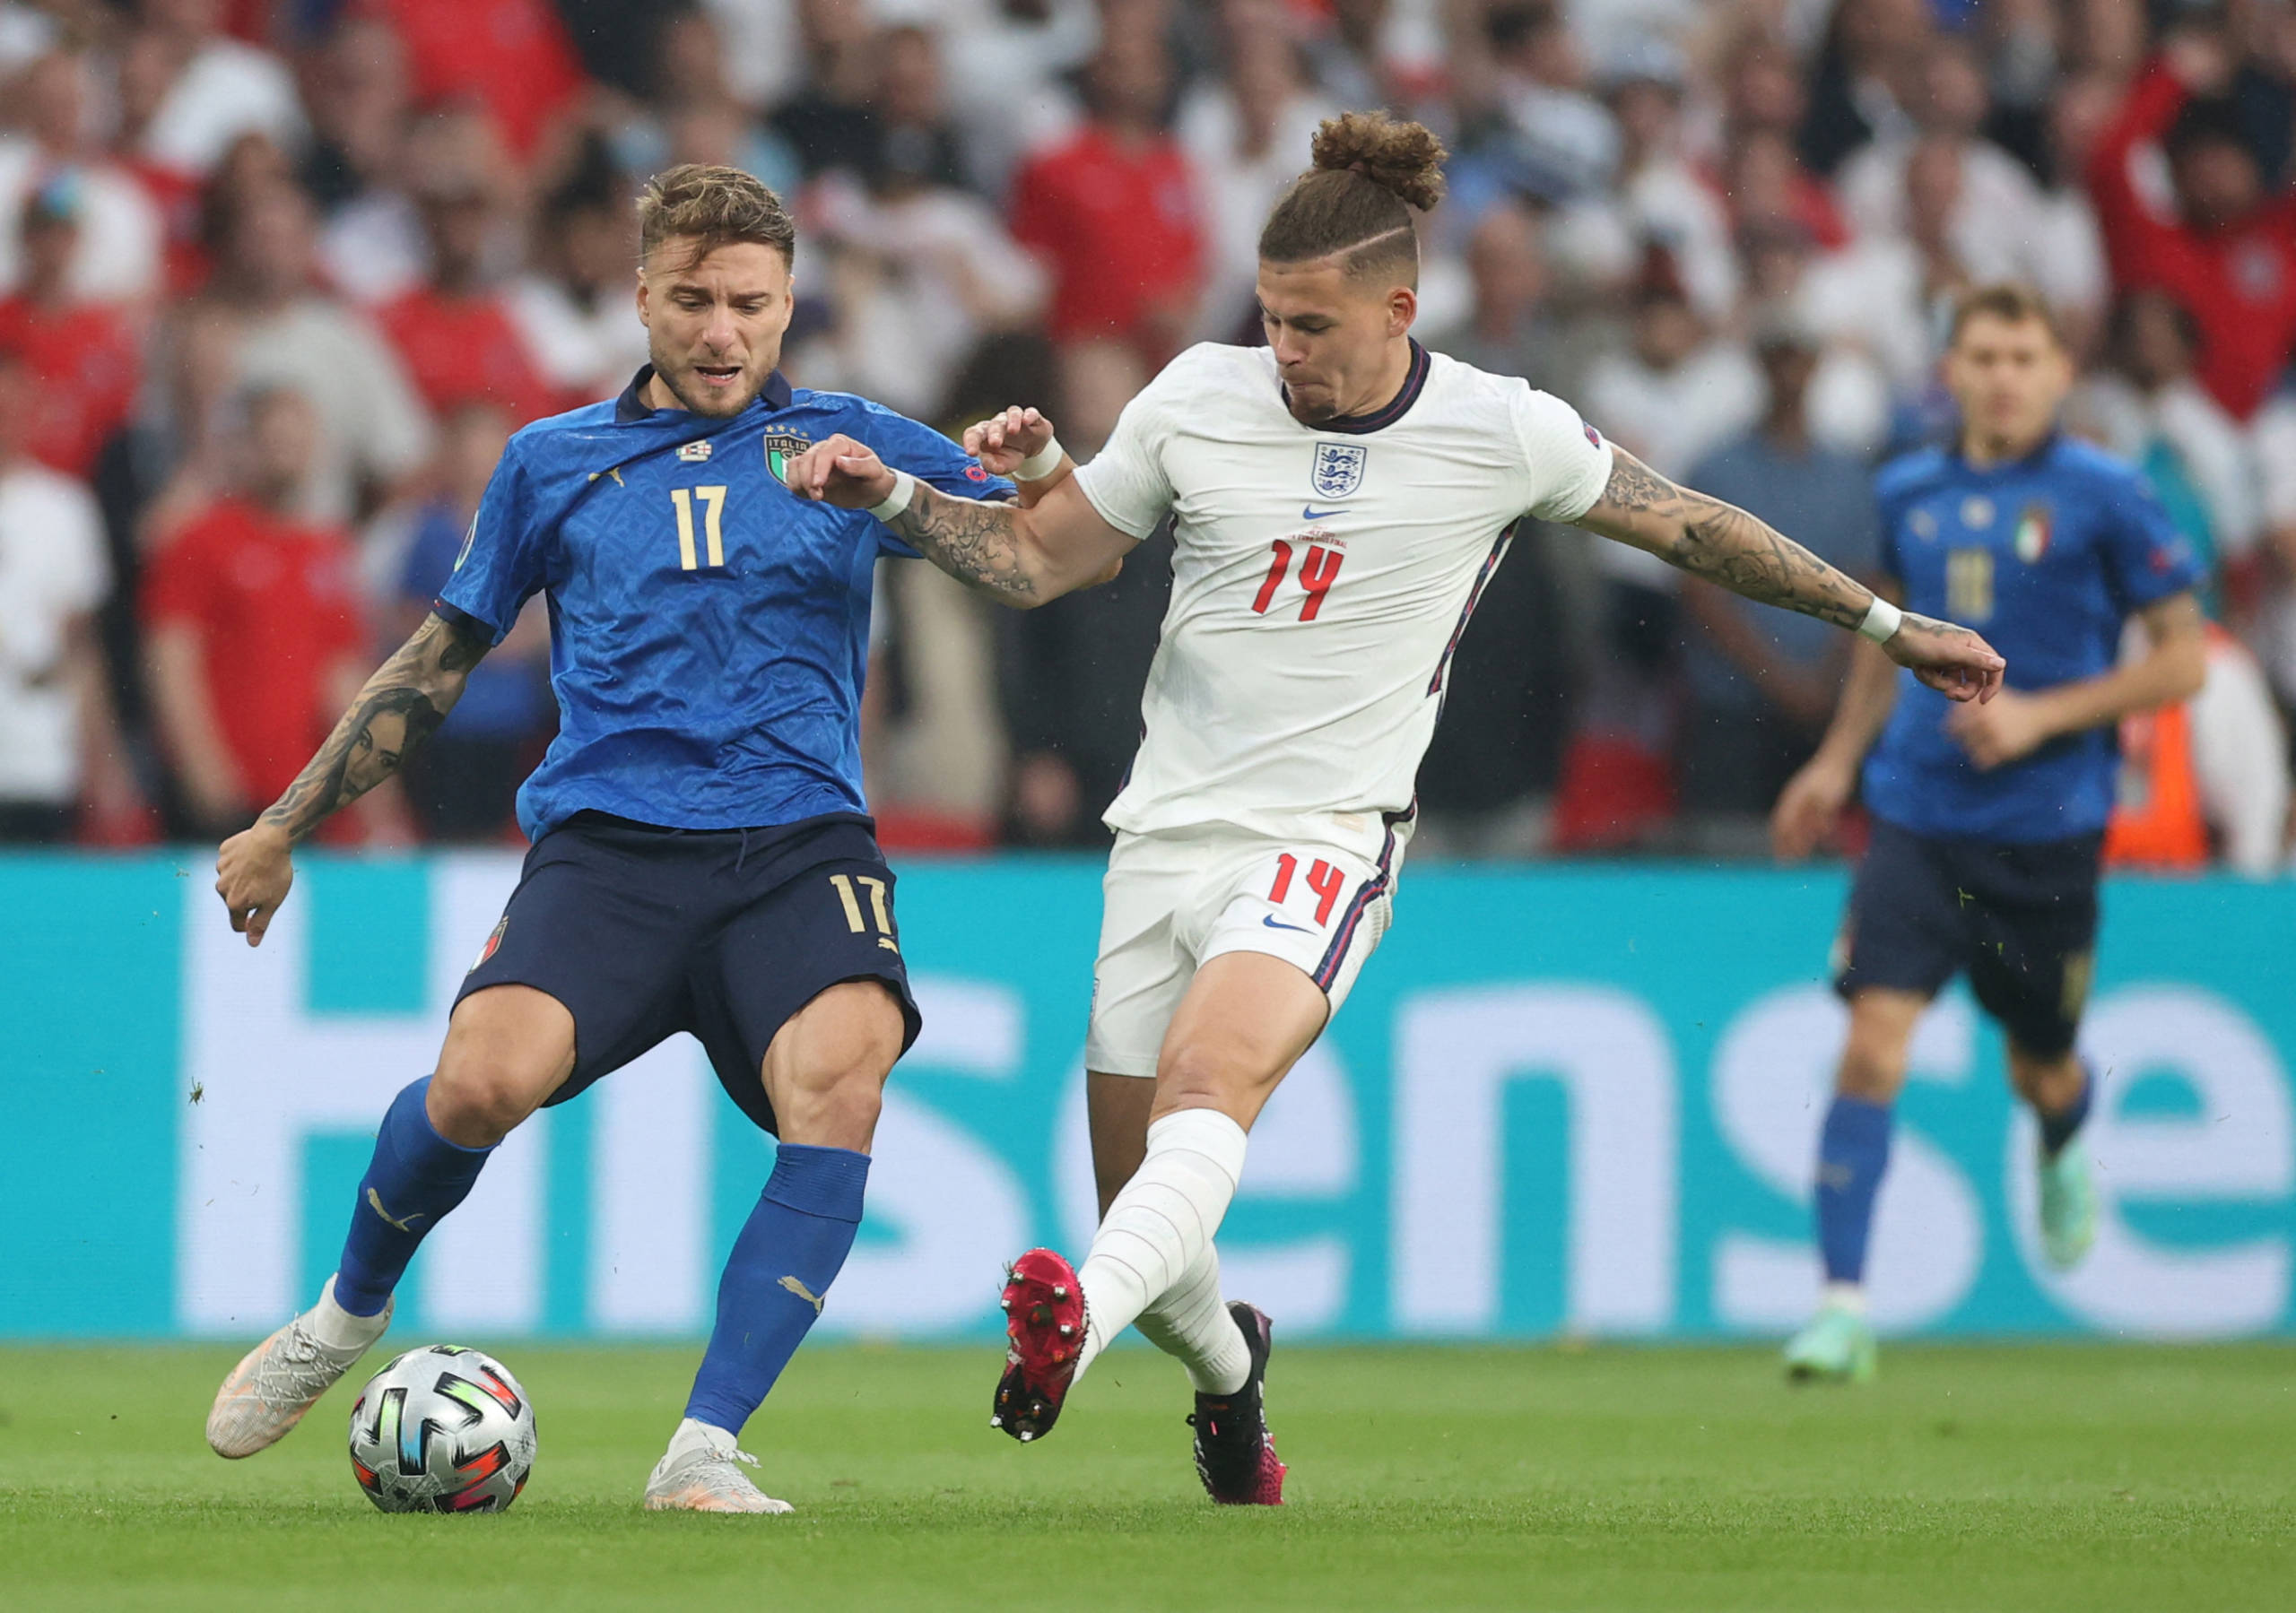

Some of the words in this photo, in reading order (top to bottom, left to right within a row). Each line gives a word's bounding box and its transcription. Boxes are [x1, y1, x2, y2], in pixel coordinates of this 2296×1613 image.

[768, 438, 807, 450] ITALIA
[670, 485, 727, 570] 17
[1252, 540, 1344, 621] 14
[829, 873, 893, 935] 17
[1267, 853, 1346, 929] 14
